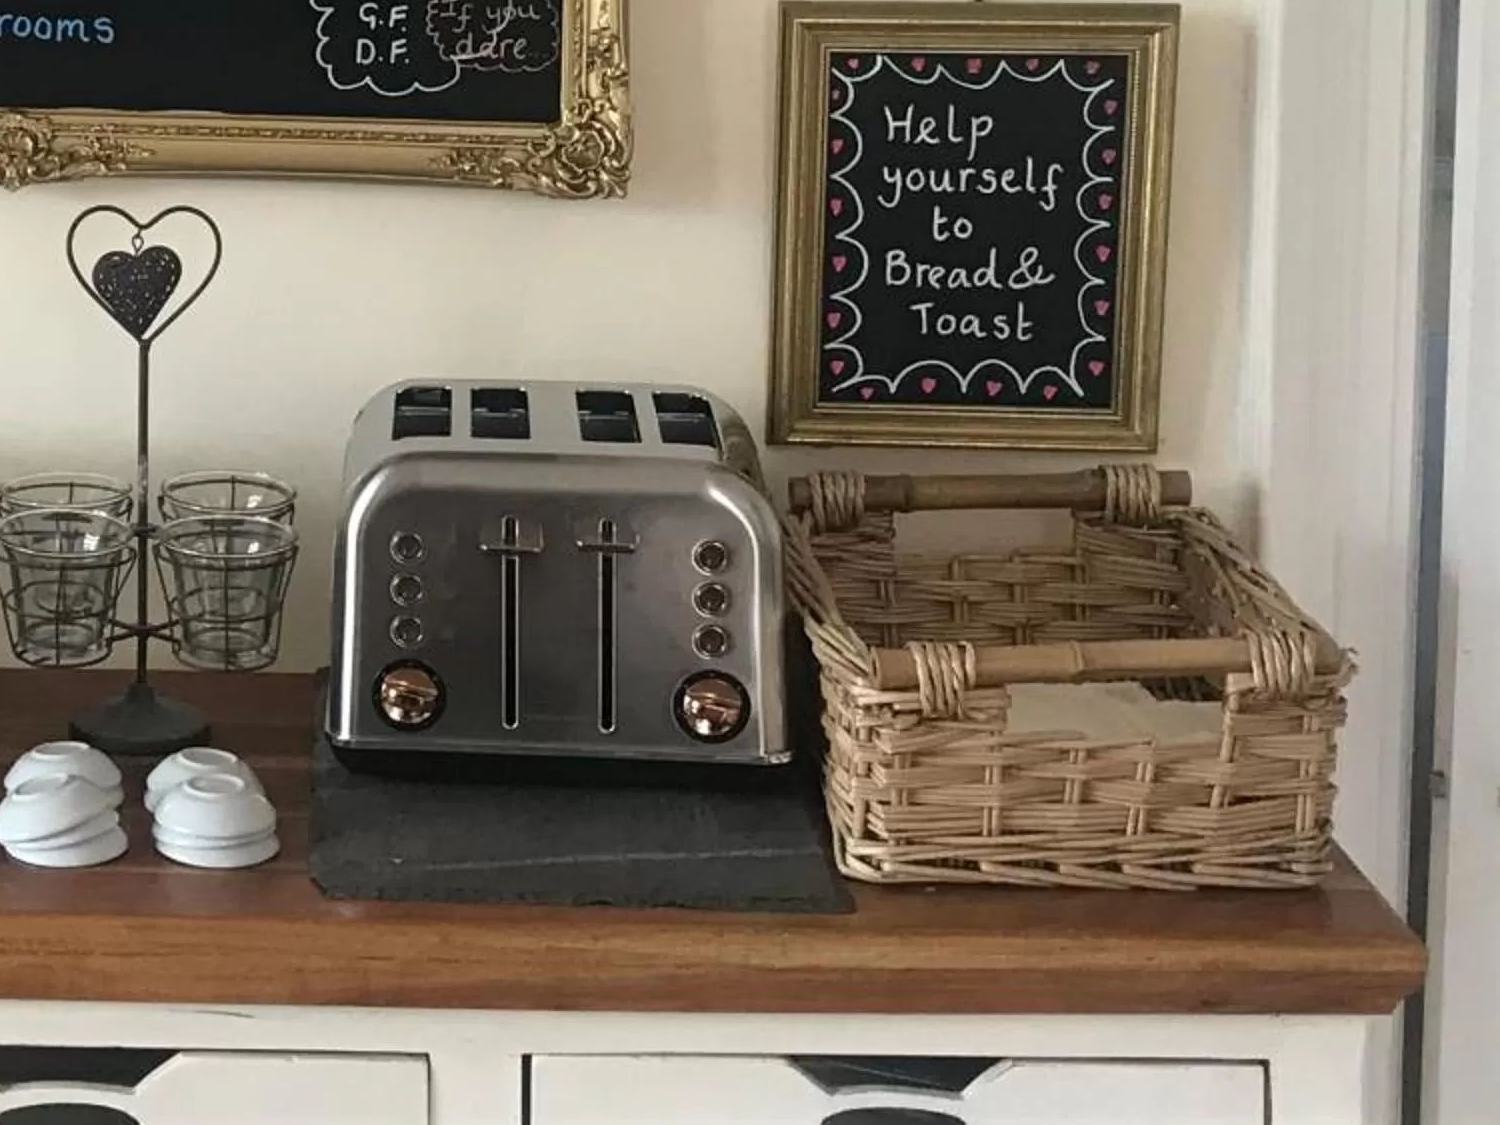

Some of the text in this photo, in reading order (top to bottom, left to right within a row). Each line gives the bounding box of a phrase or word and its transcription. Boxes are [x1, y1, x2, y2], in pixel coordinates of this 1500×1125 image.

[482, 4, 540, 34] you
[884, 104, 993, 161] Help
[877, 156, 1063, 211] yourself
[933, 205, 973, 241] to
[885, 247, 1001, 290] Bread
[910, 301, 1033, 341] Toast
